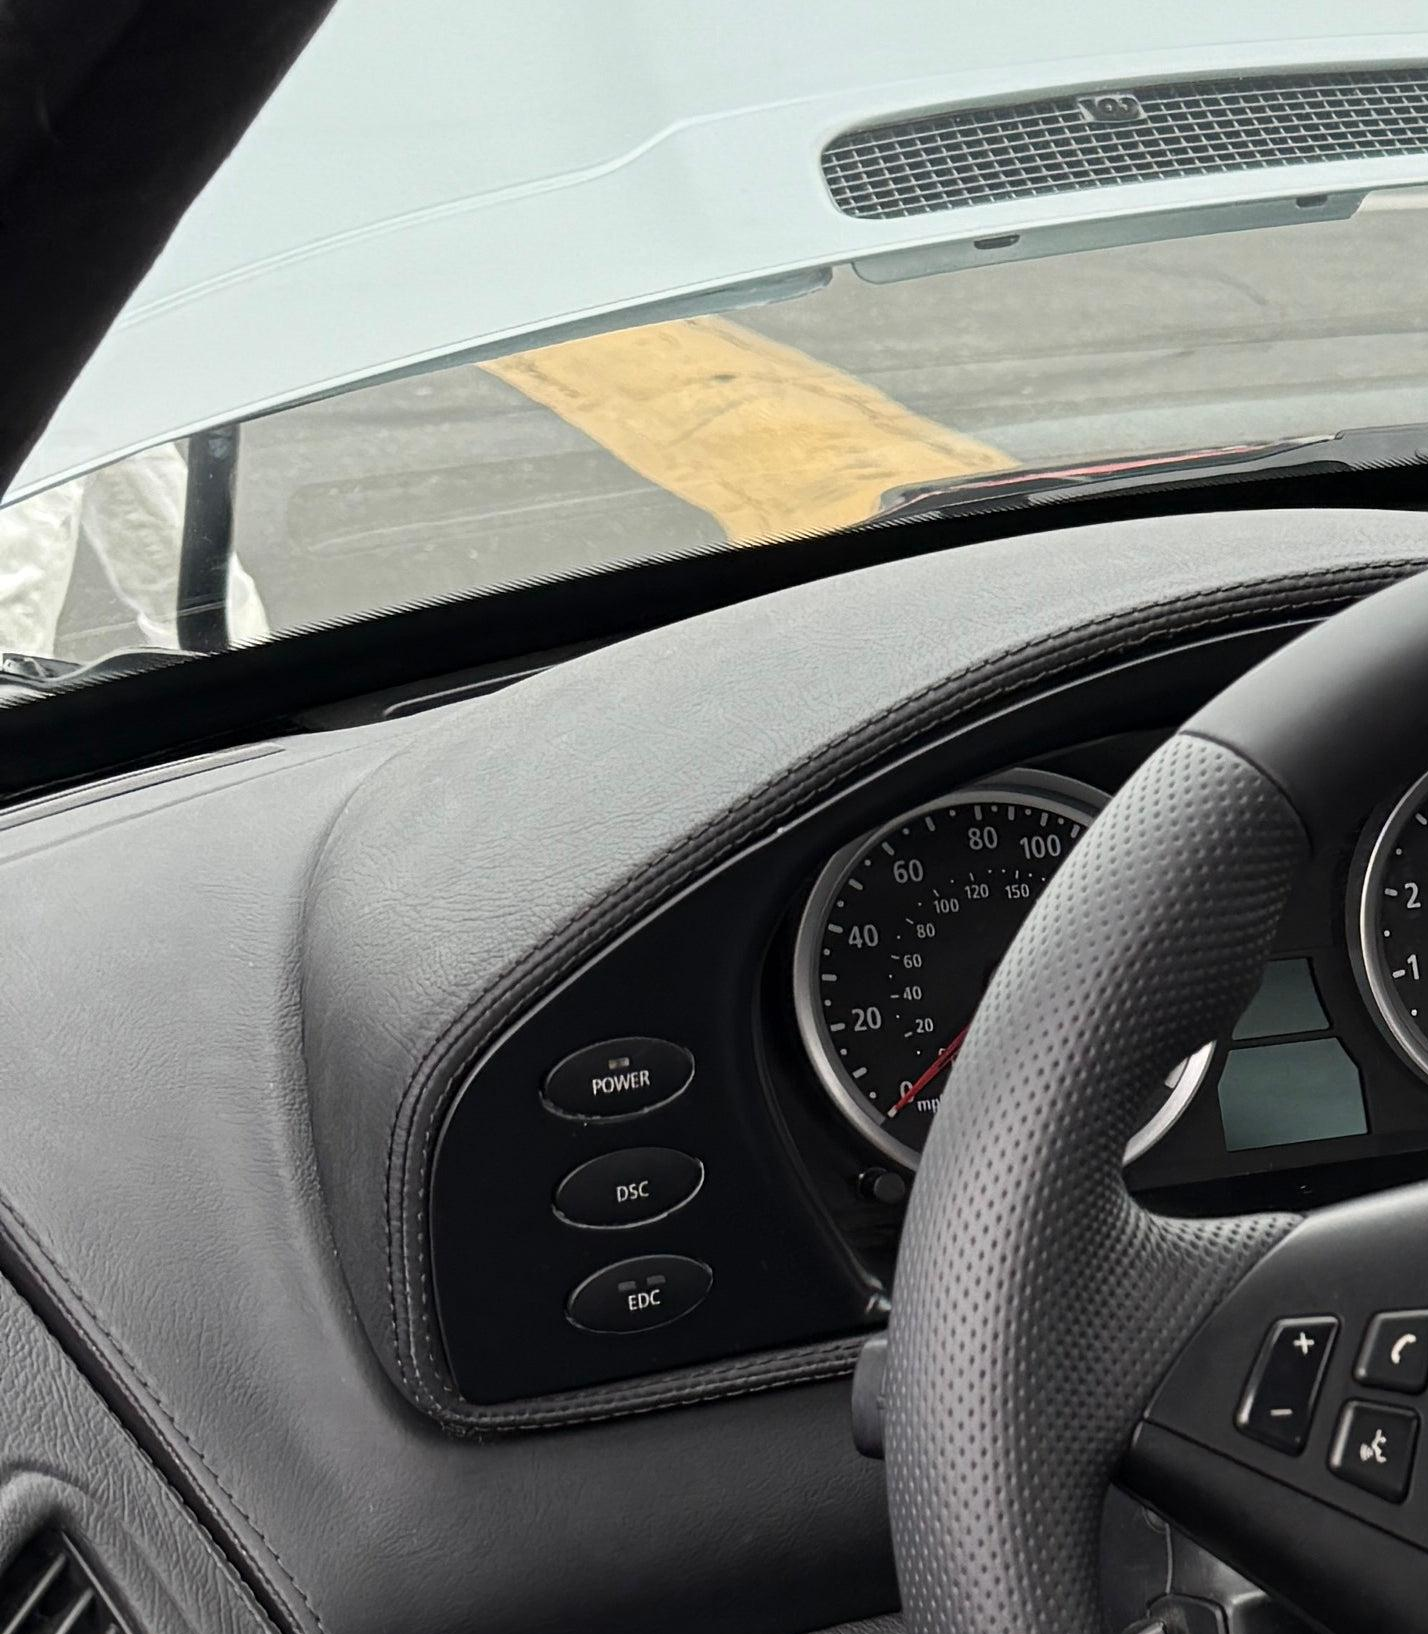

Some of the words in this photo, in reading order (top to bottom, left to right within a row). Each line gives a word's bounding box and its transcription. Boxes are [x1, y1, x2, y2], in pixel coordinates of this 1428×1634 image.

[968, 826, 998, 850] 80
[1020, 834, 1062, 859] 100
[893, 859, 924, 884] 60
[964, 884, 990, 900] 120
[1005, 884, 1030, 900] 150
[1405, 883, 1421, 909] 2
[934, 897, 960, 914] 100
[848, 924, 879, 949] 40
[916, 923, 936, 939] 80
[903, 953, 922, 969] 60
[1407, 954, 1420, 980] 1
[903, 986, 922, 1001] 40
[852, 1007, 882, 1032] 20
[915, 1018, 934, 1034] 20
[592, 1070, 650, 1096] POWER
[900, 1081, 914, 1102] 0
[917, 1098, 941, 1113] mp
[616, 1181, 649, 1203] DSC
[628, 1289, 661, 1311] EDC
